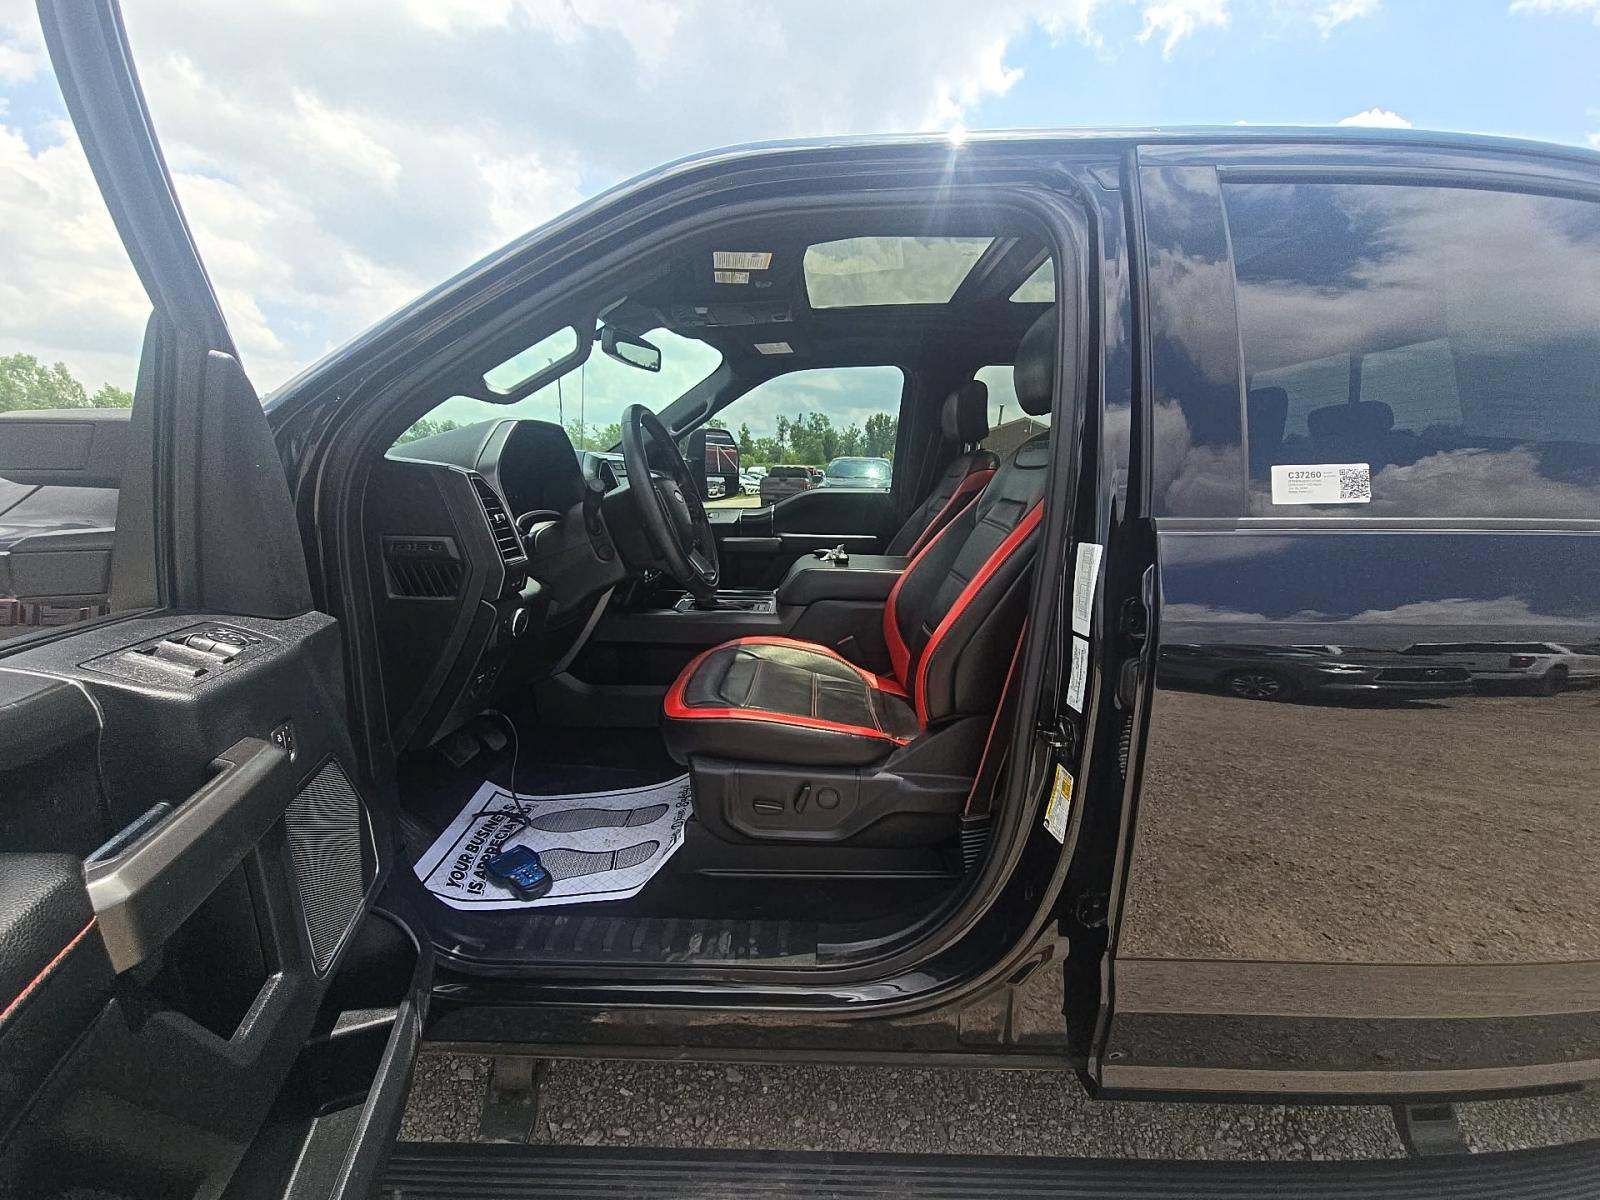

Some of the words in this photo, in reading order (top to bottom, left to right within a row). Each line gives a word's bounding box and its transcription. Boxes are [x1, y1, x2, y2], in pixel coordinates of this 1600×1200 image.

[1288, 471, 1321, 479] C37260
[446, 854, 475, 889] YOUR
[465, 804, 517, 853] BUSINES
[474, 803, 539, 881] APPRECIAD!
[467, 880, 486, 895] IS
